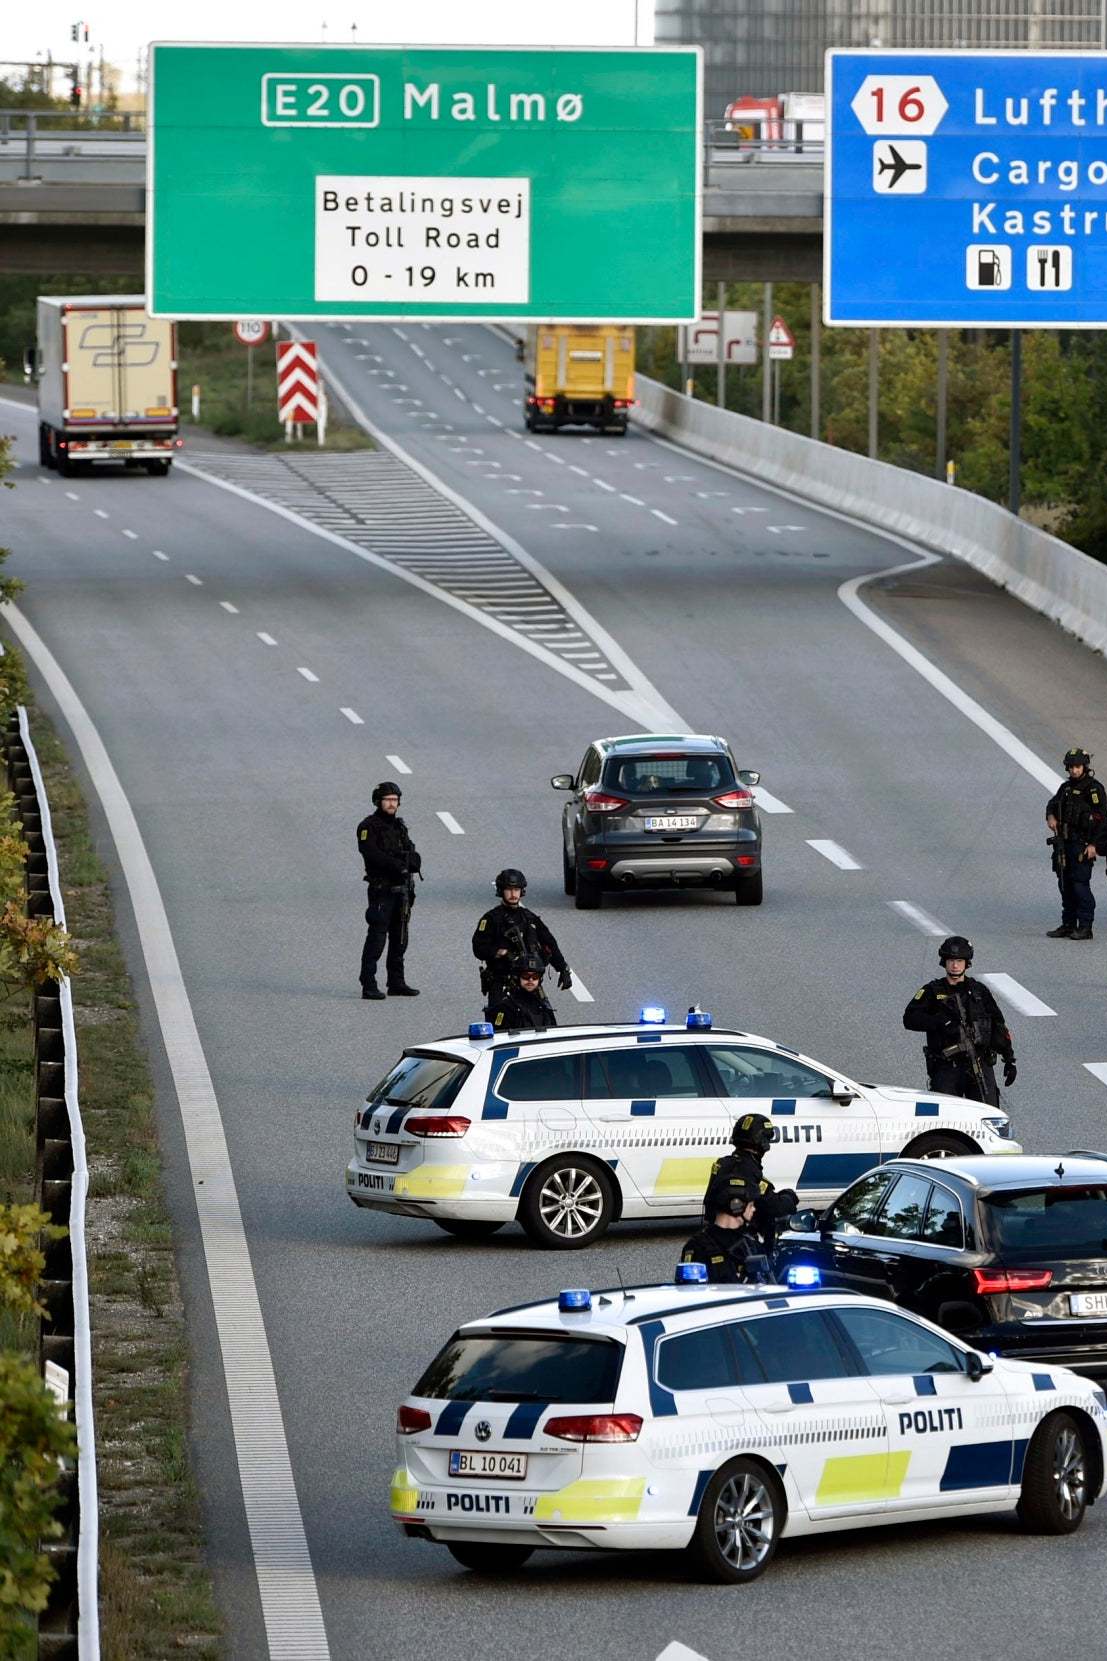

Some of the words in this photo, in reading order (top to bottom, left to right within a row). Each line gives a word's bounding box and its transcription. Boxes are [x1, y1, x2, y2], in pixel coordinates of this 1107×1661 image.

[275, 84, 366, 117] E20
[404, 83, 583, 121] Malmø
[870, 86, 926, 122] 16
[323, 190, 522, 219] Betalingsvej
[346, 226, 405, 248] Toll
[425, 226, 501, 249] Road
[351, 265, 368, 287] 0
[405, 265, 436, 287] 19
[456, 266, 496, 288] km
[768, 1124, 823, 1144] OLITI
[358, 1172, 385, 1190] POLITI
[898, 1407, 963, 1436] POLITI
[459, 1453, 477, 1472] BL
[481, 1454, 496, 1473] 10
[499, 1456, 523, 1474] 041
[446, 1493, 510, 1514] POLITI
